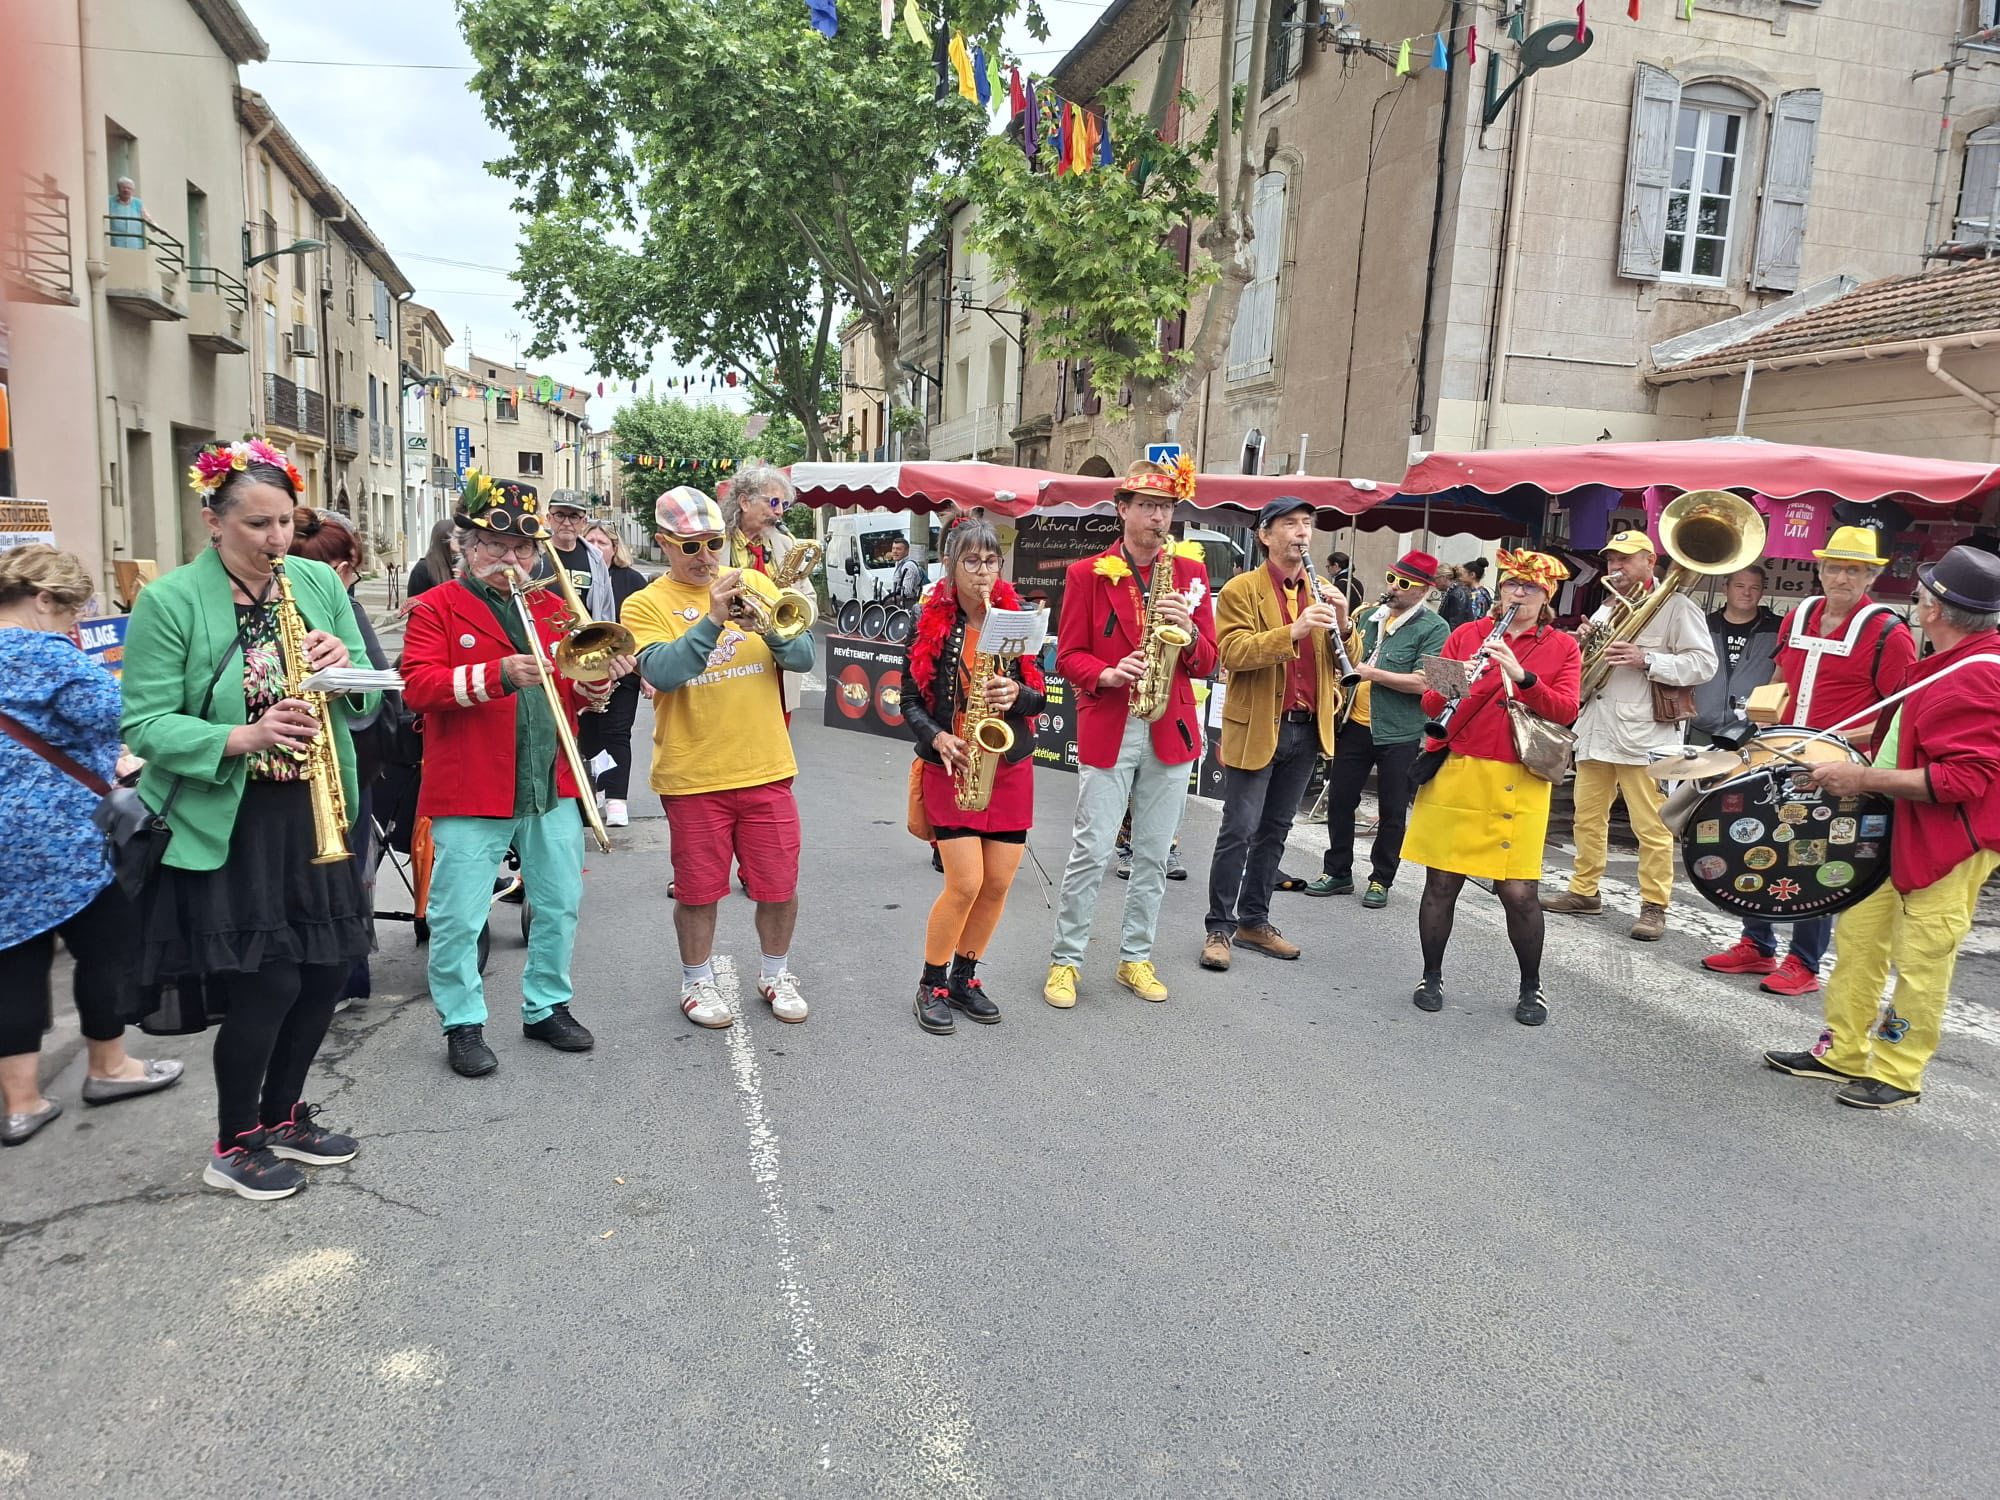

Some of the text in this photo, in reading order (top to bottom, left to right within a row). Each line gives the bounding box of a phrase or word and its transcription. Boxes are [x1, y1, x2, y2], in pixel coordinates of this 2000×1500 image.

[1030, 517, 1121, 533] Natural Cook
[1784, 524, 1809, 538] TATA
[1018, 577, 1058, 586] REVÊTEMENT
[1775, 575, 1804, 591] les
[80, 624, 118, 650] BLAGE
[834, 646, 875, 661] REVÊTEMENT
